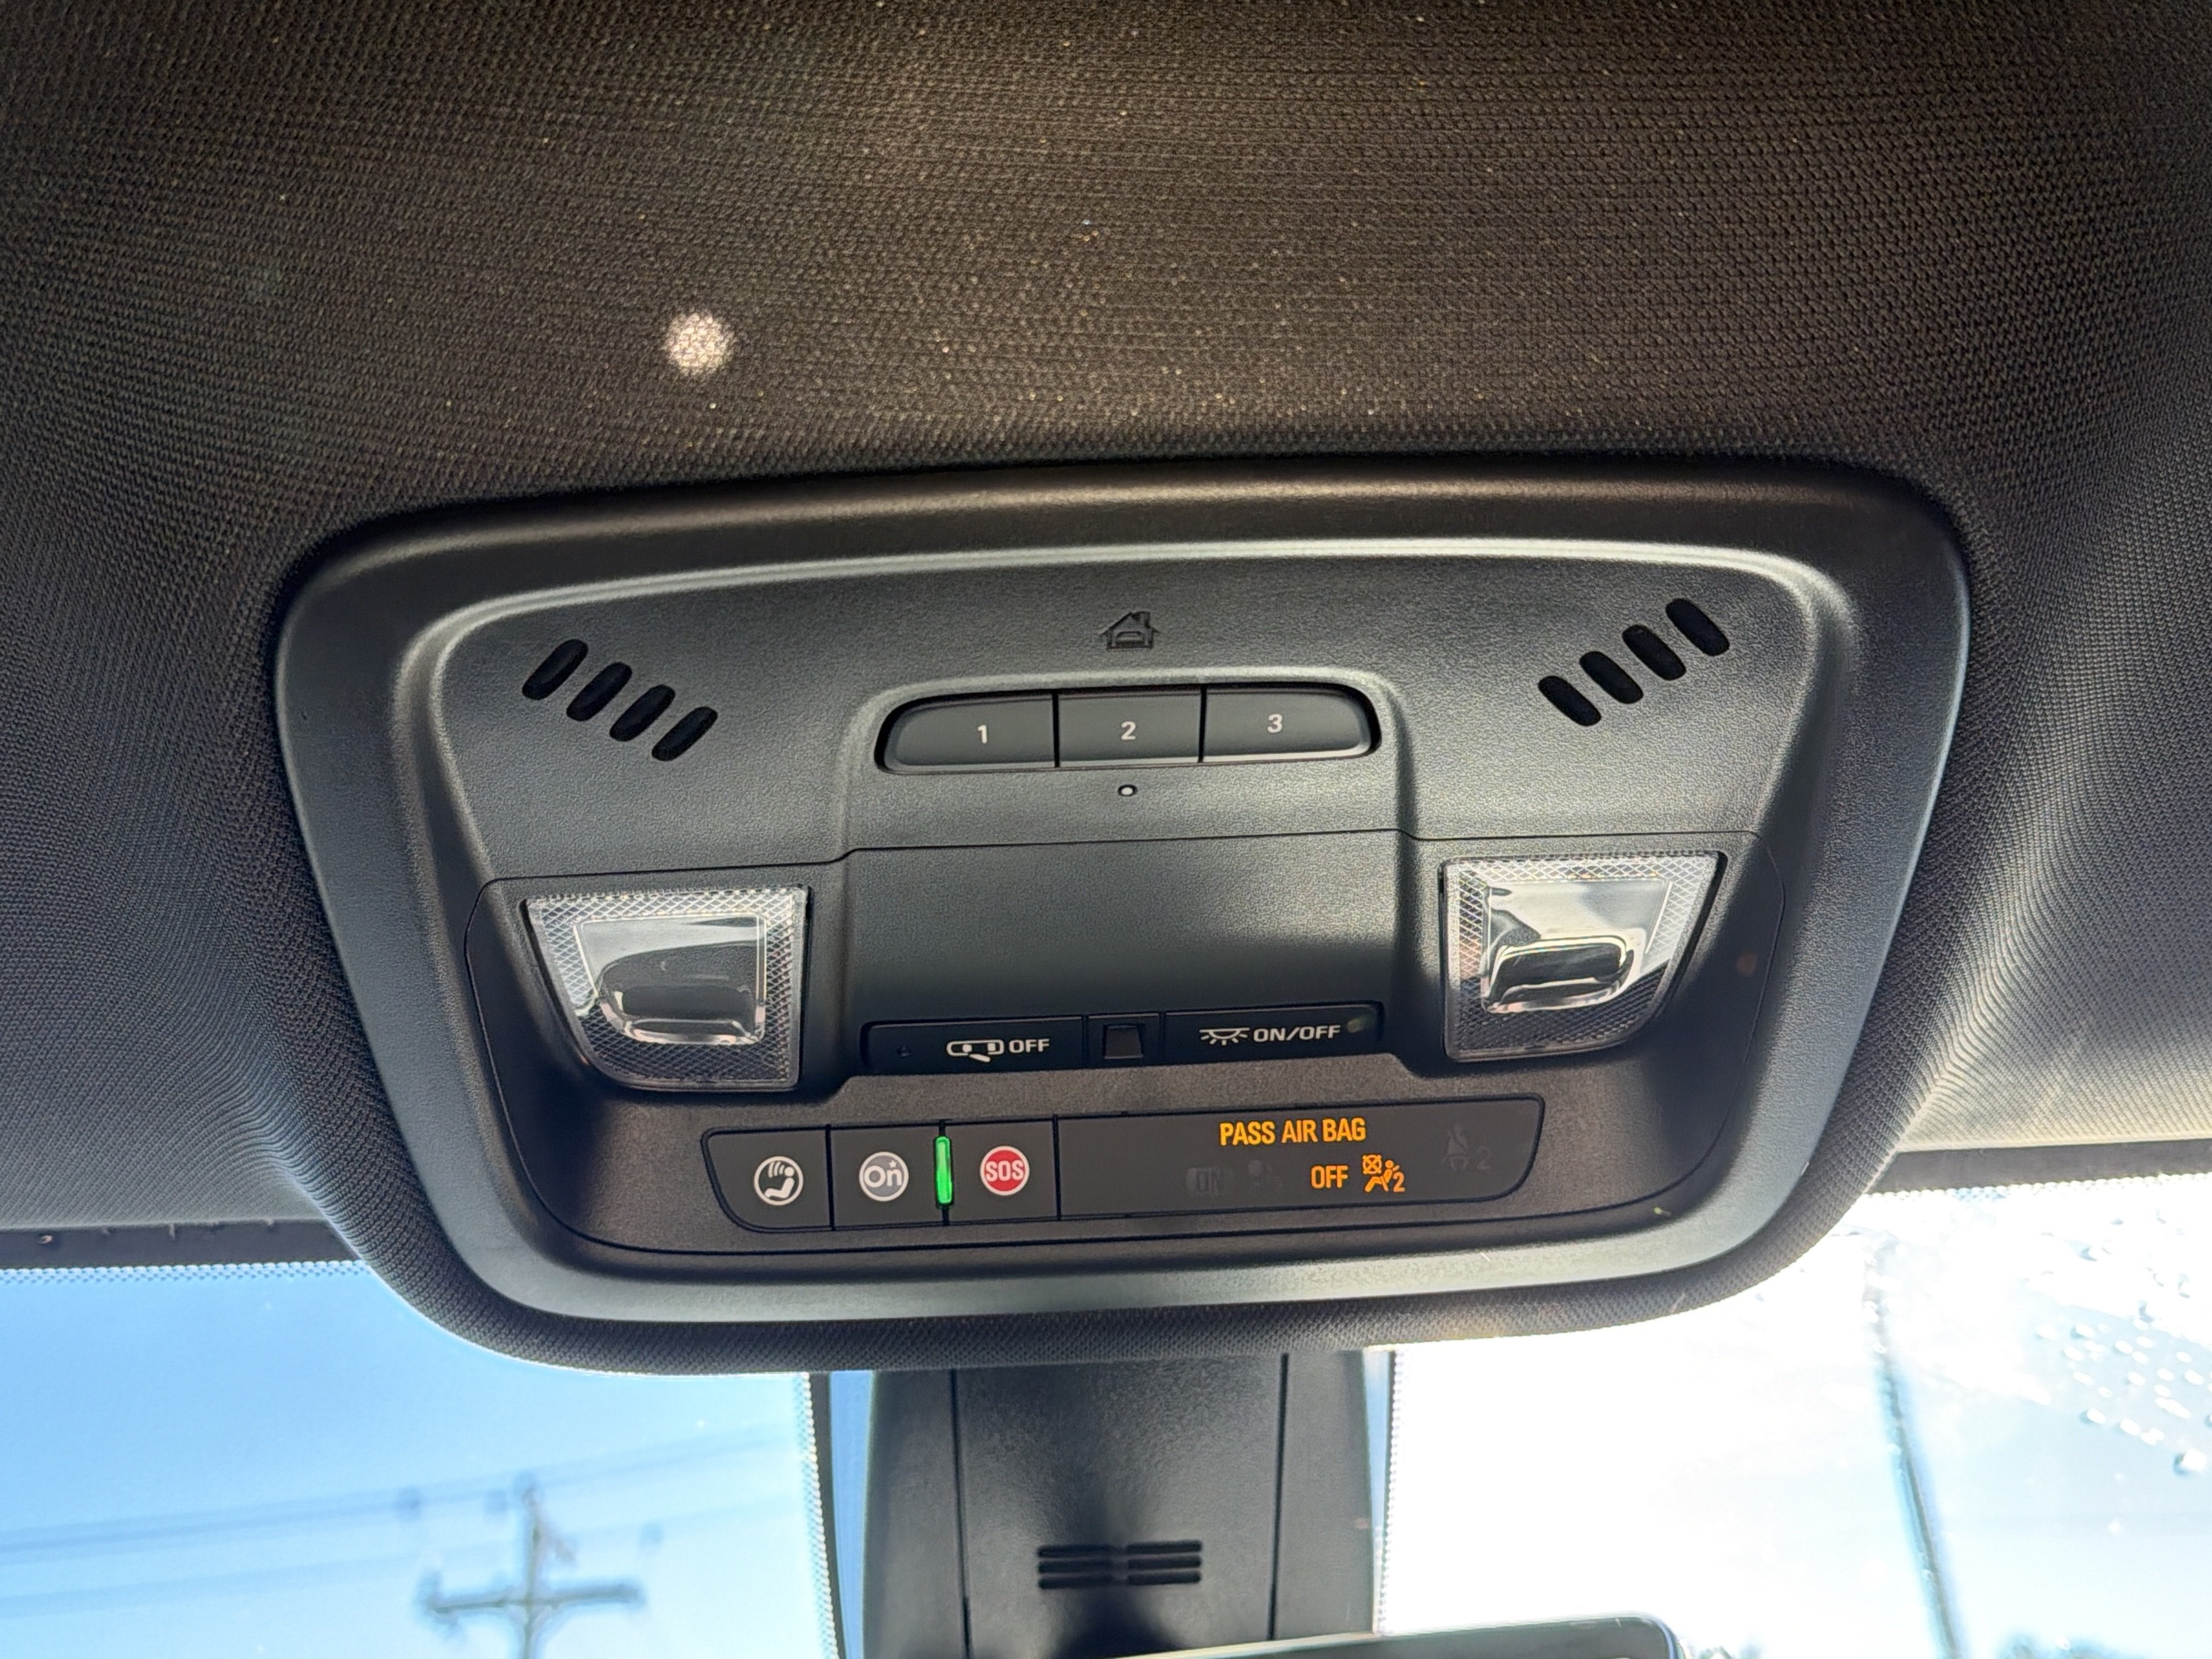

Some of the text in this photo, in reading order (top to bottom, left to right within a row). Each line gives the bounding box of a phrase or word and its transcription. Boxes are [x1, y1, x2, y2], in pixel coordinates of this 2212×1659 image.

[1121, 721, 1136, 740] 2
[1267, 714, 1283, 733] 3
[978, 725, 987, 744] 1
[1254, 1025, 1341, 1042] ON/OFF
[1009, 1039, 1049, 1053] OFF
[1220, 1118, 1366, 1146] PASS AIR BAG
[864, 1164, 902, 1188] On
[985, 1160, 1025, 1182] SOS
[1311, 1165, 1406, 1193] OFF 2
